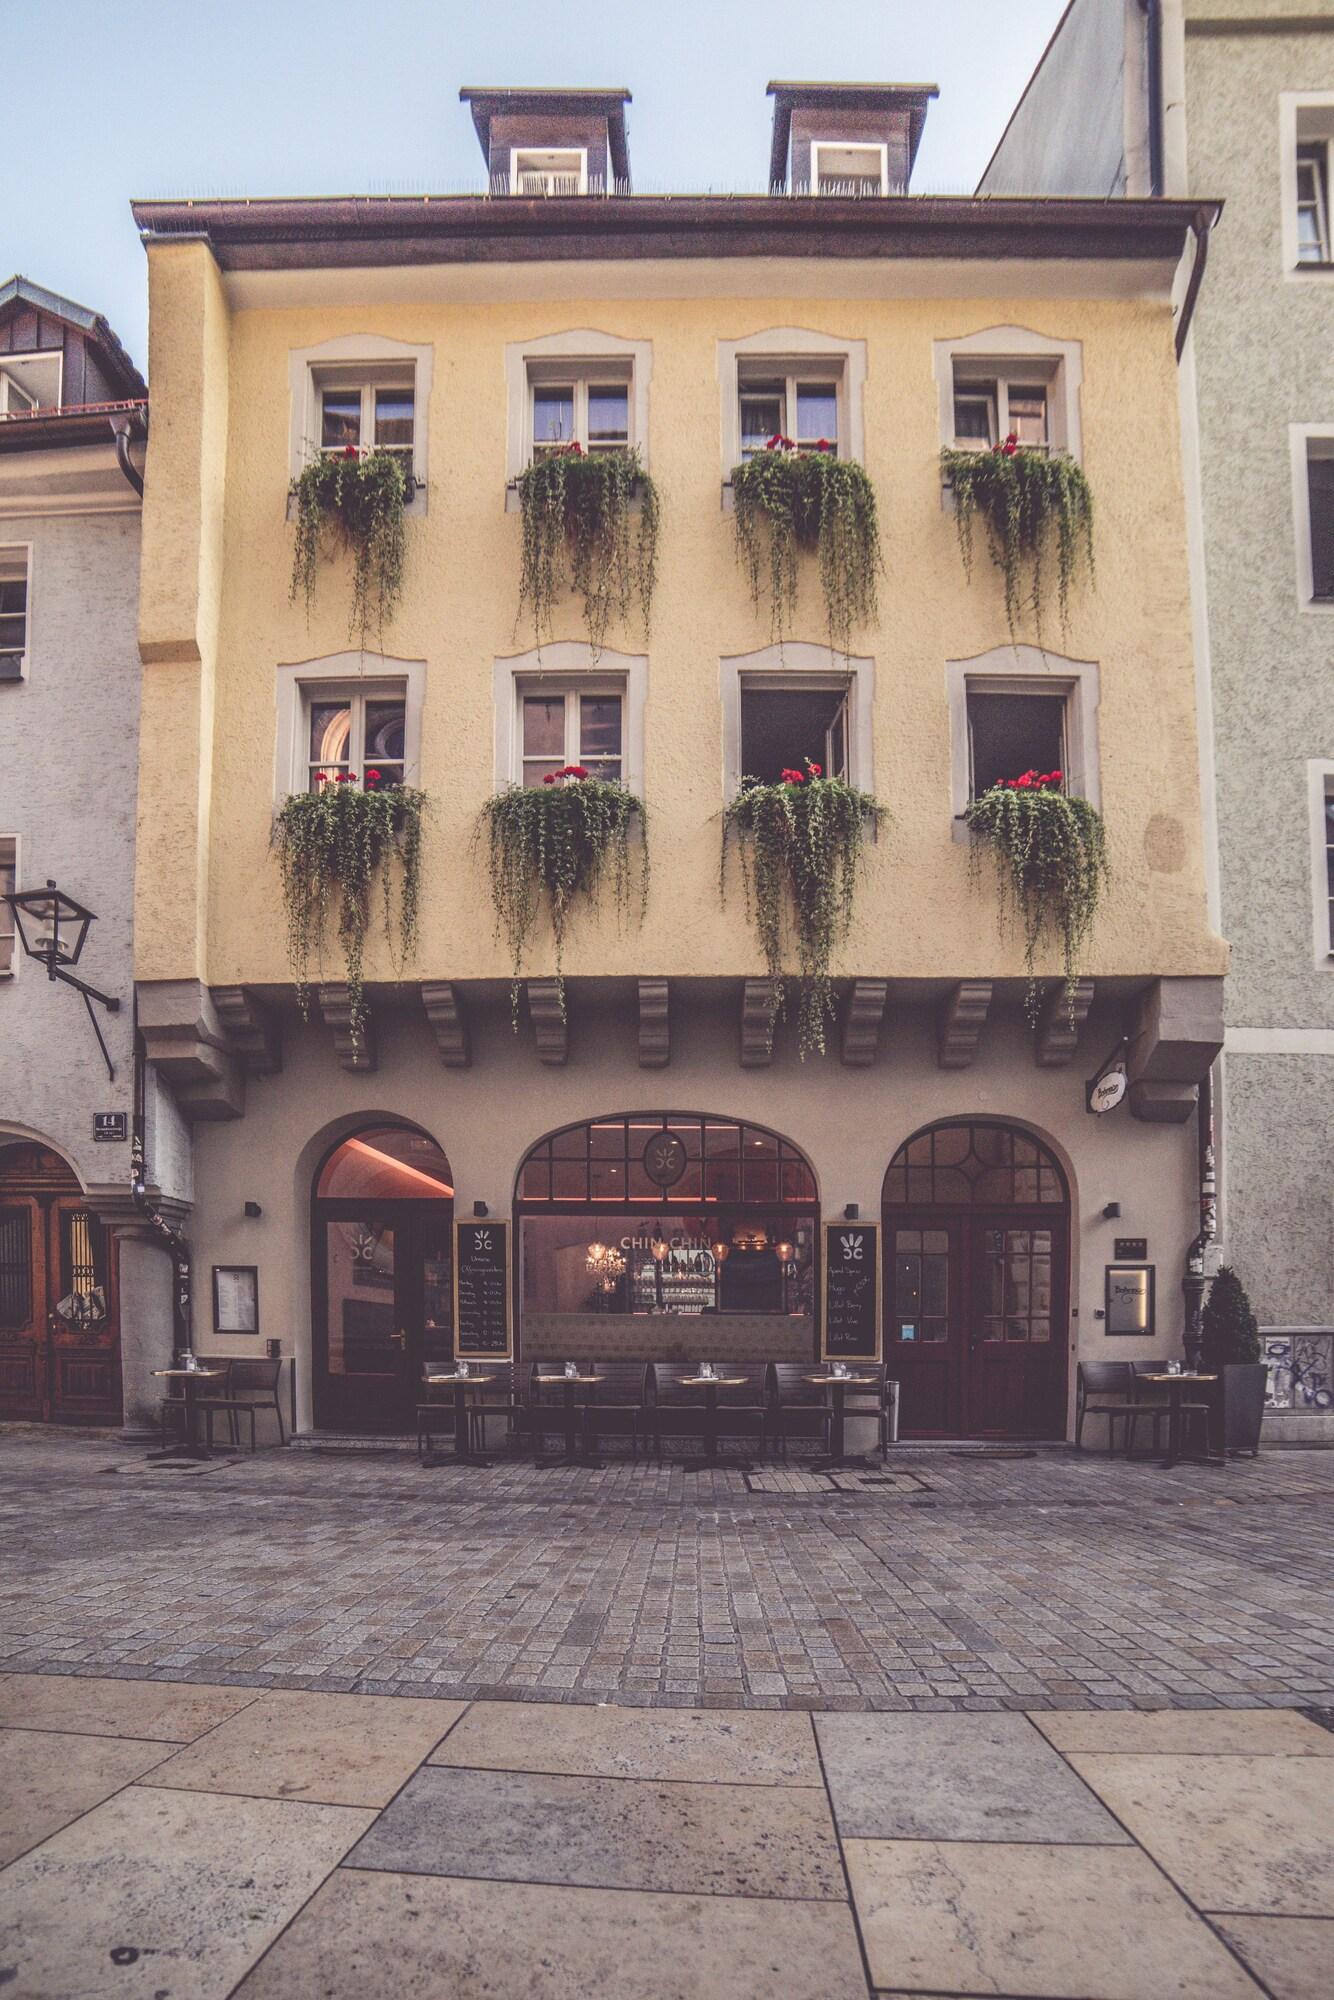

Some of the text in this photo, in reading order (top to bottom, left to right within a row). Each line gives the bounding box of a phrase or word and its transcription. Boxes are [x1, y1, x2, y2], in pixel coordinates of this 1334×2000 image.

[102, 1115, 115, 1126] 14
[620, 1236, 712, 1250] CHIN CHIN
